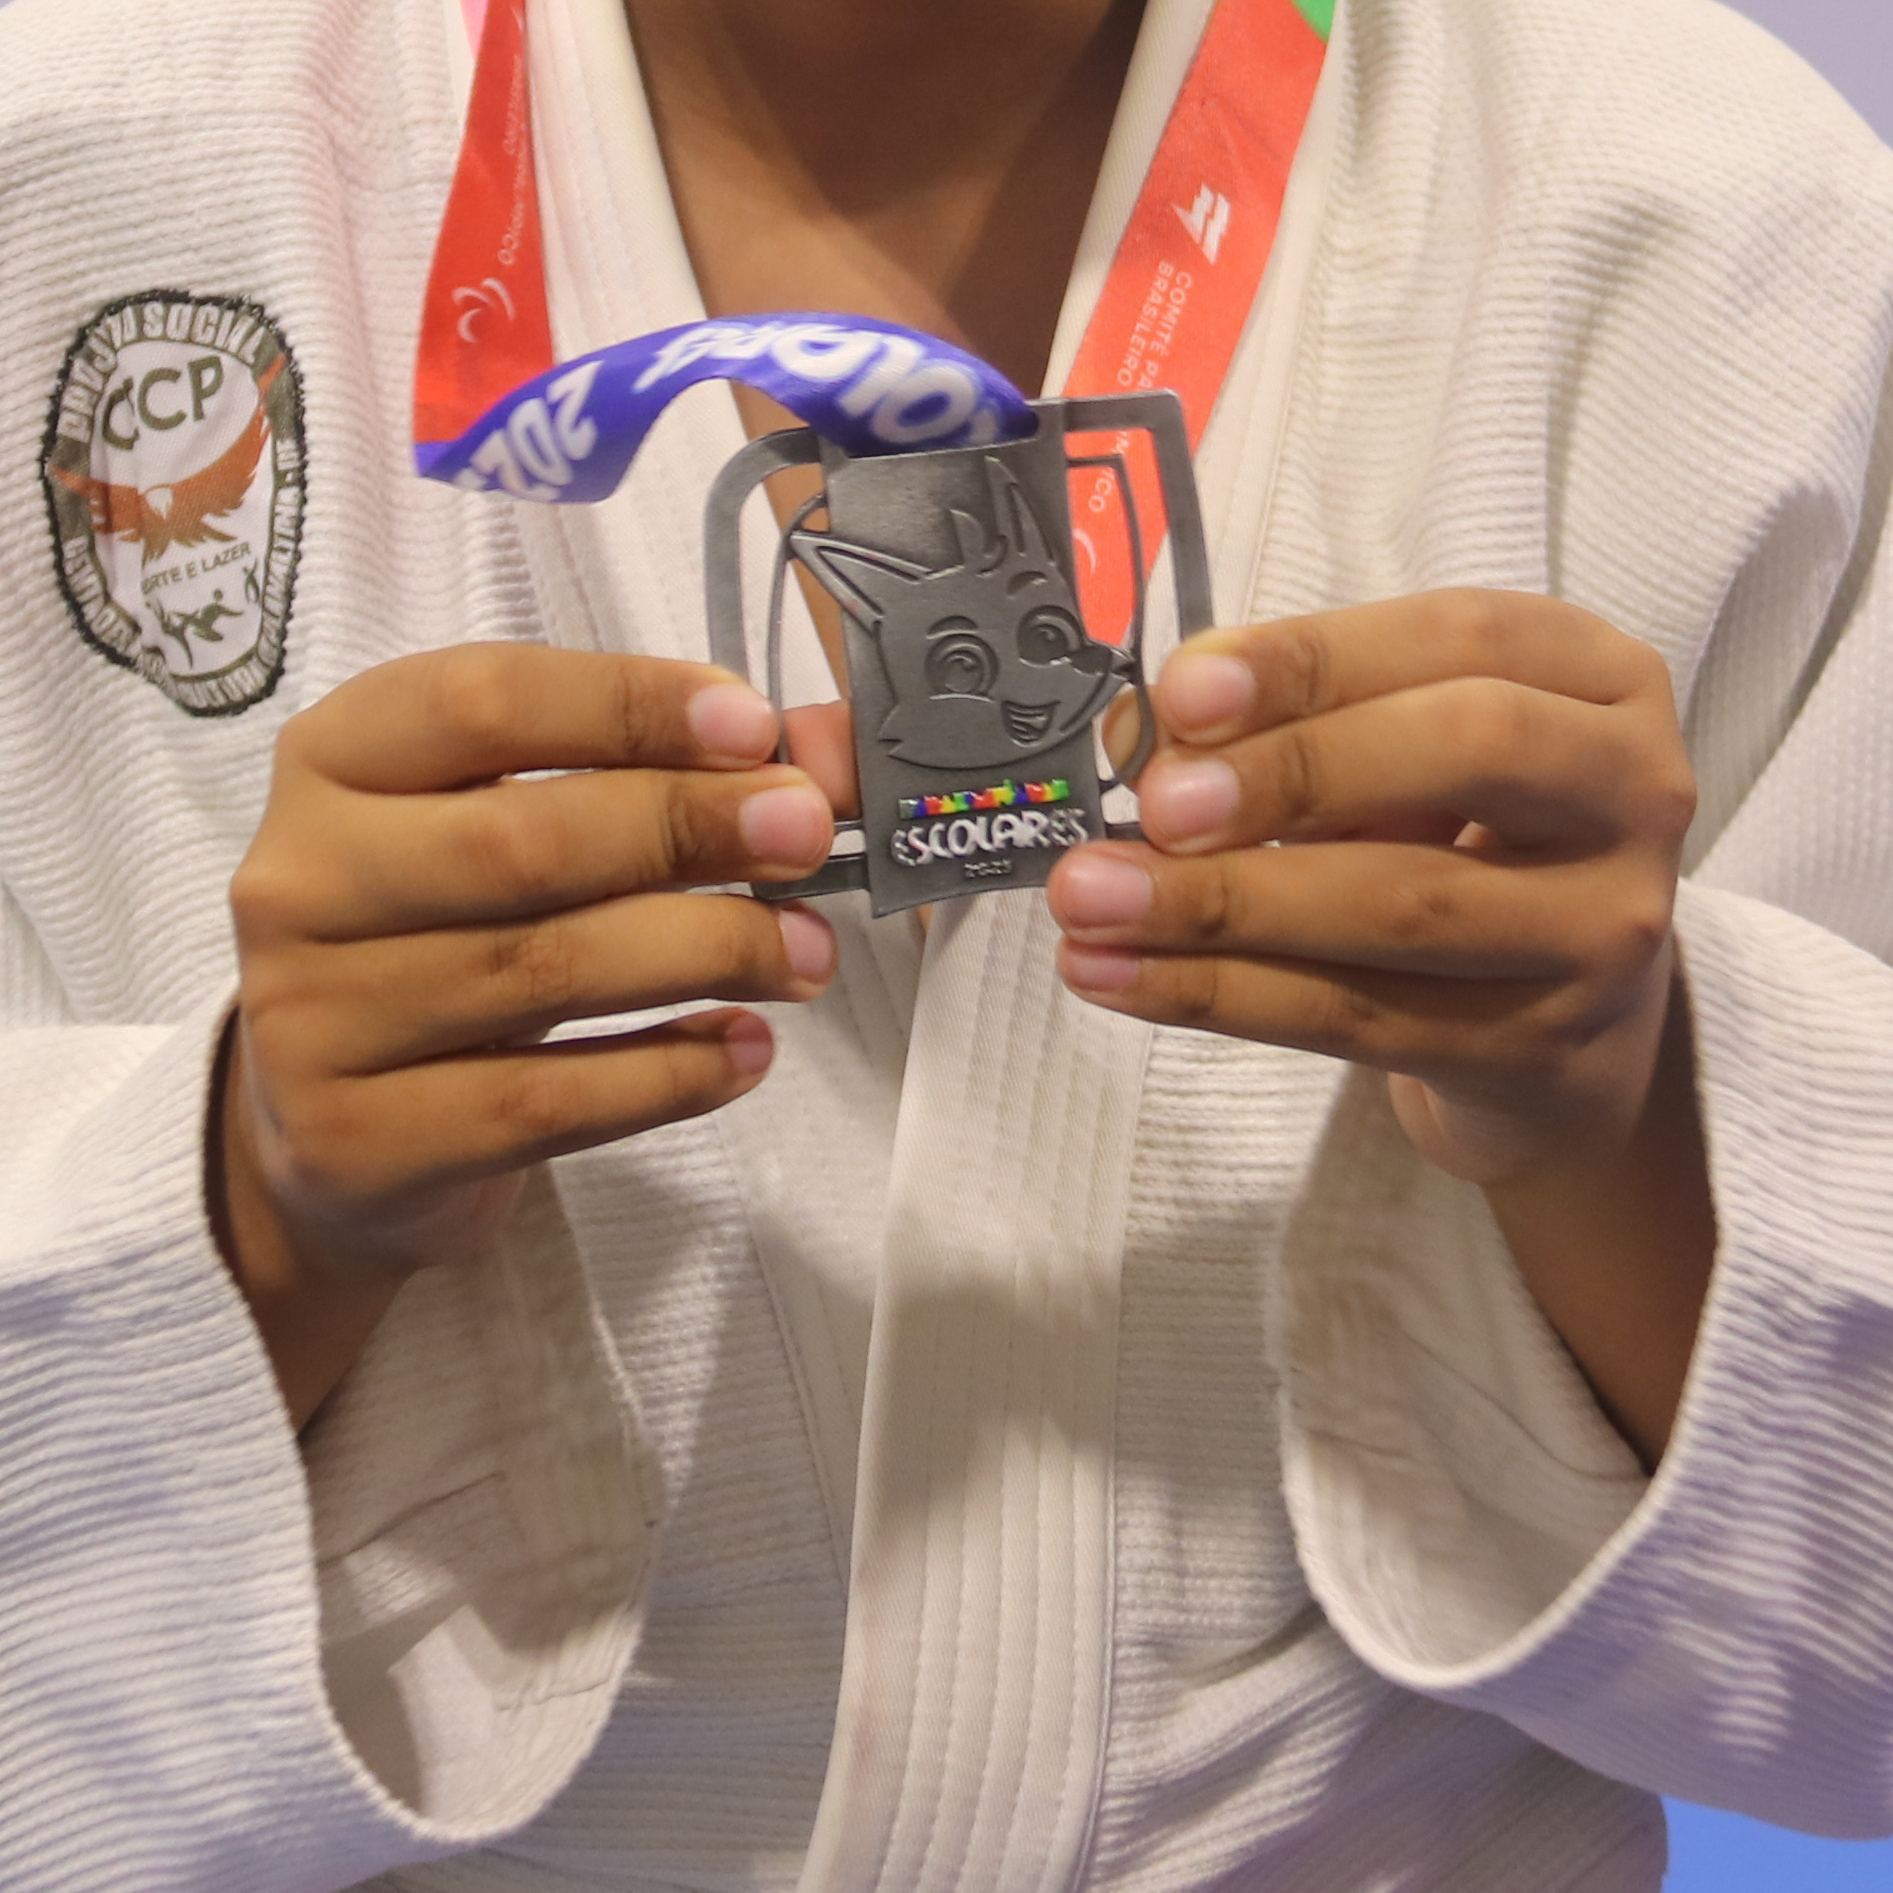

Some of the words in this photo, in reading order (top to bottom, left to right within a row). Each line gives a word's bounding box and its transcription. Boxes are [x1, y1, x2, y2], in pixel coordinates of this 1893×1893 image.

[1117, 259, 1175, 388] BRASILEIRO
[1149, 270, 1194, 358] COMITÊ
[102, 355, 224, 451] CCP
[186, 561, 197, 579] E
[201, 541, 251, 572] LAZER
[890, 808, 1089, 867] ESCOLARES
